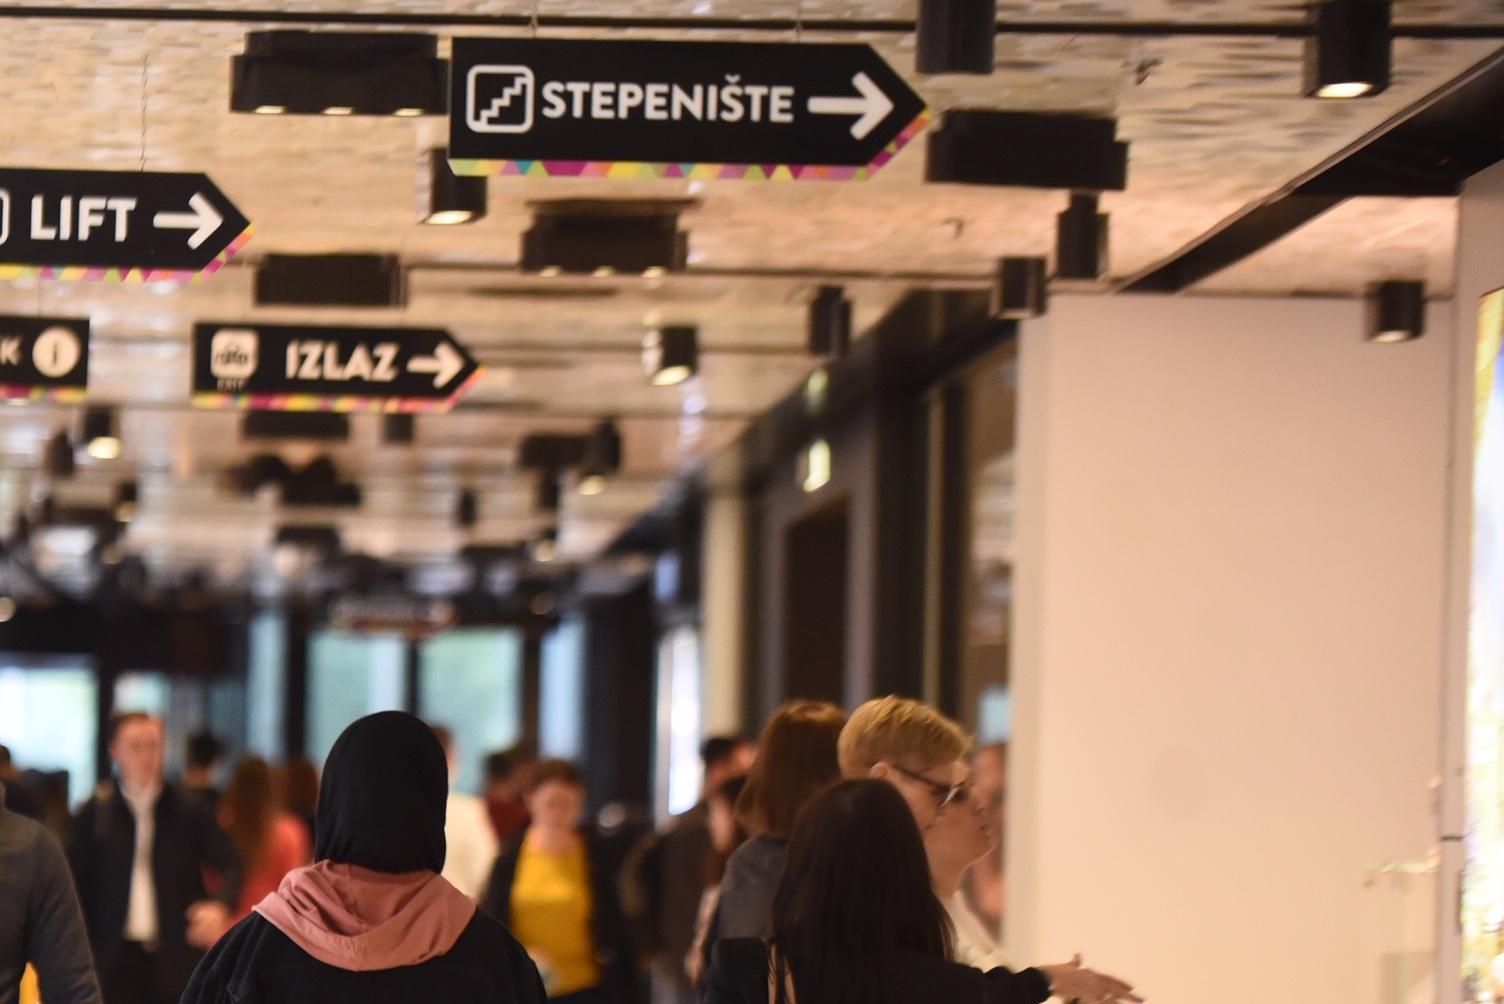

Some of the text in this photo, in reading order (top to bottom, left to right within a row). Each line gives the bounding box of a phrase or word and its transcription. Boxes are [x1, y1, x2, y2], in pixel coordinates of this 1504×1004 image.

[541, 74, 795, 122] STEPENIŠTE
[29, 195, 137, 242] LIFT
[285, 341, 399, 382] IZLAZ
